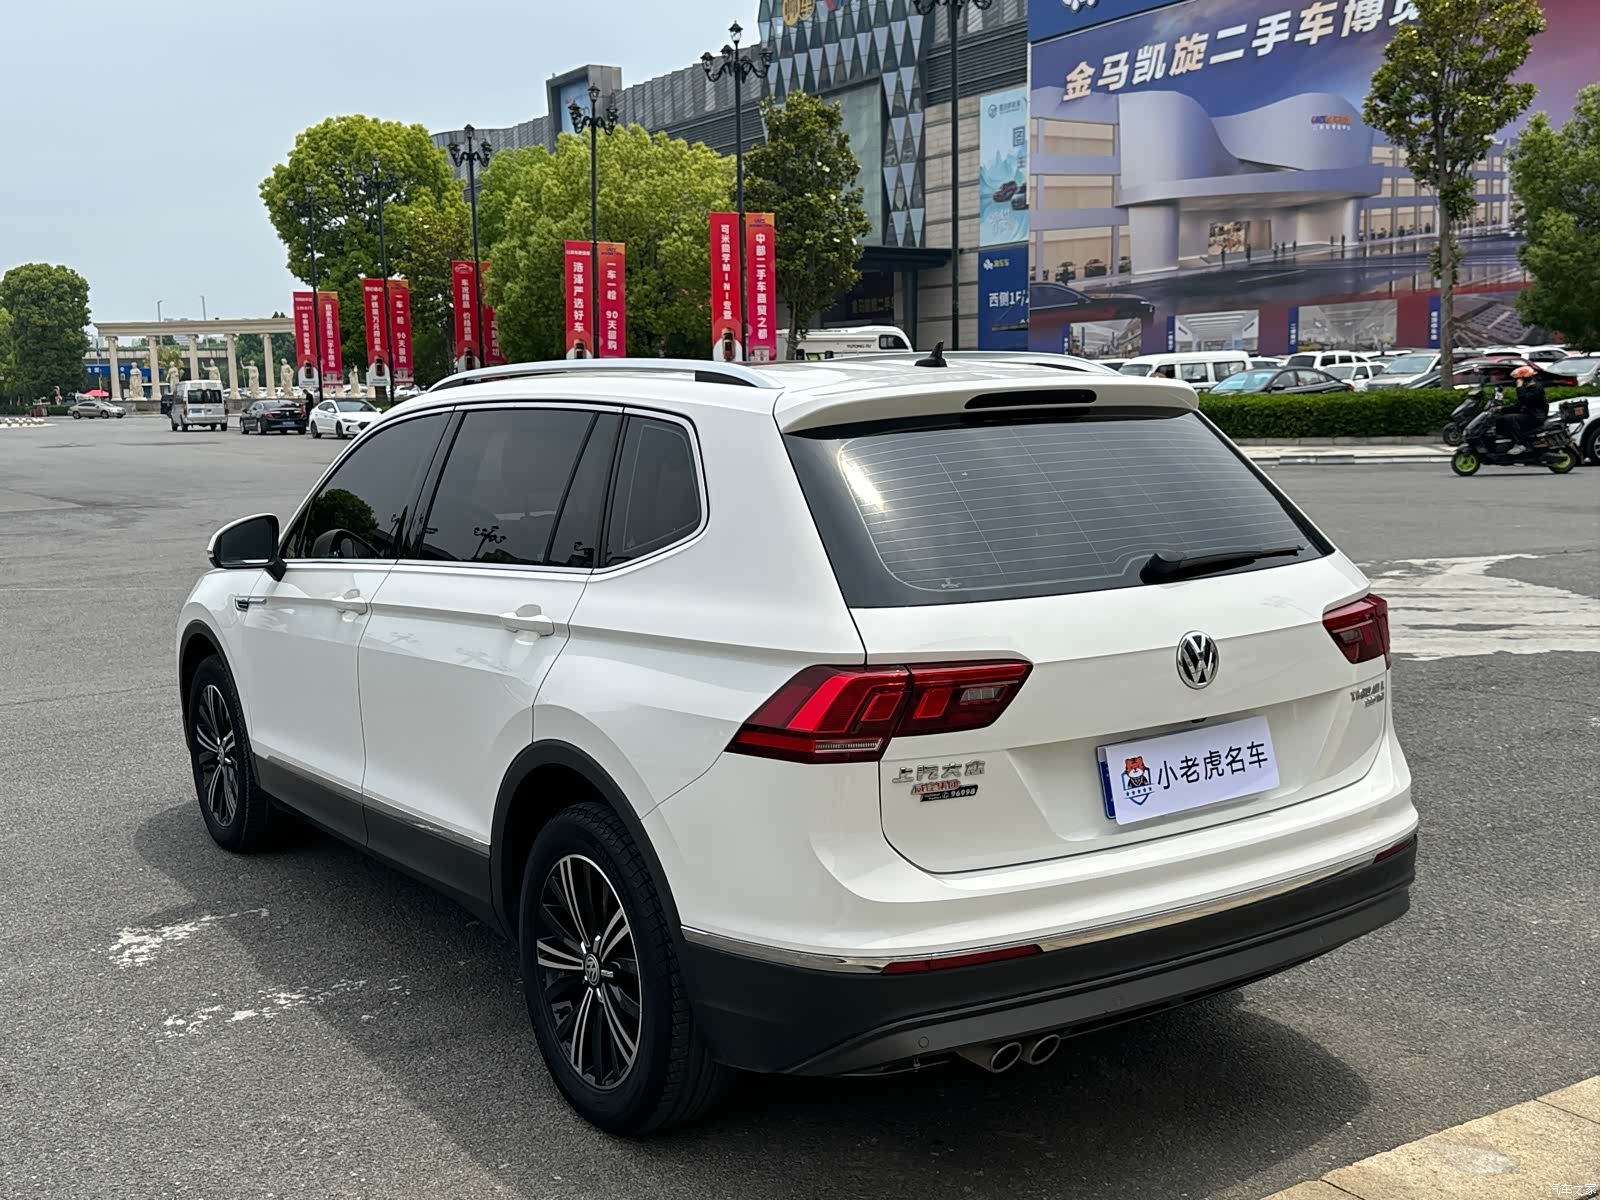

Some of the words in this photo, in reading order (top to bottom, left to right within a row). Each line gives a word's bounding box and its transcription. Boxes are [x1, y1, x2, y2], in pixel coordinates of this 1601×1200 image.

[892, 759, 986, 784] 上汽大众
[1157, 740, 1269, 790] 小老虎名车
